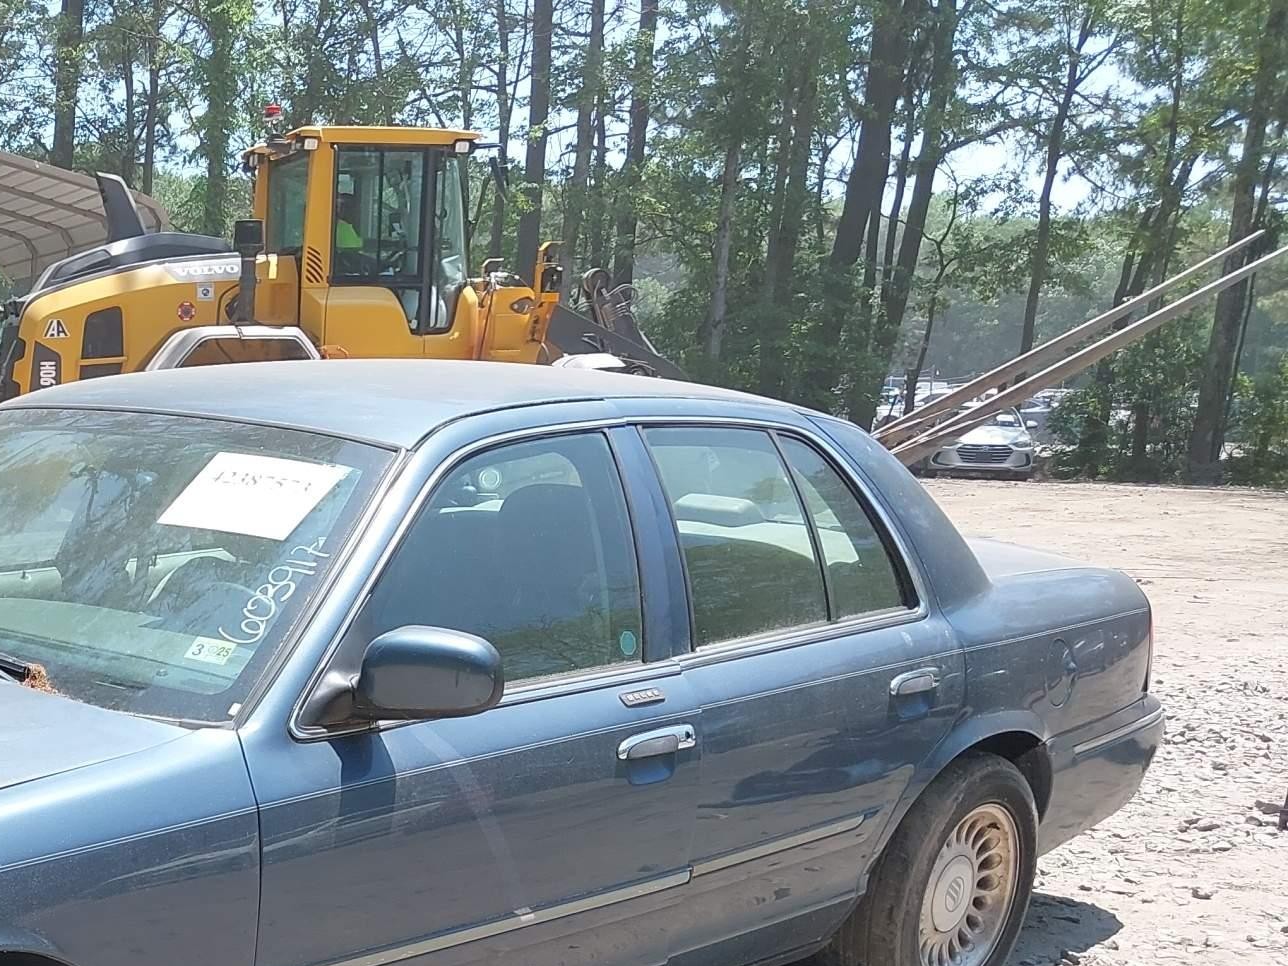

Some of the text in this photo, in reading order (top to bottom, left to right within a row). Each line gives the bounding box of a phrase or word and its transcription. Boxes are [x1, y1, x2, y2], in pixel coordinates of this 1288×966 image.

[174, 264, 239, 276] VOLVO
[191, 643, 232, 658] 3 25
